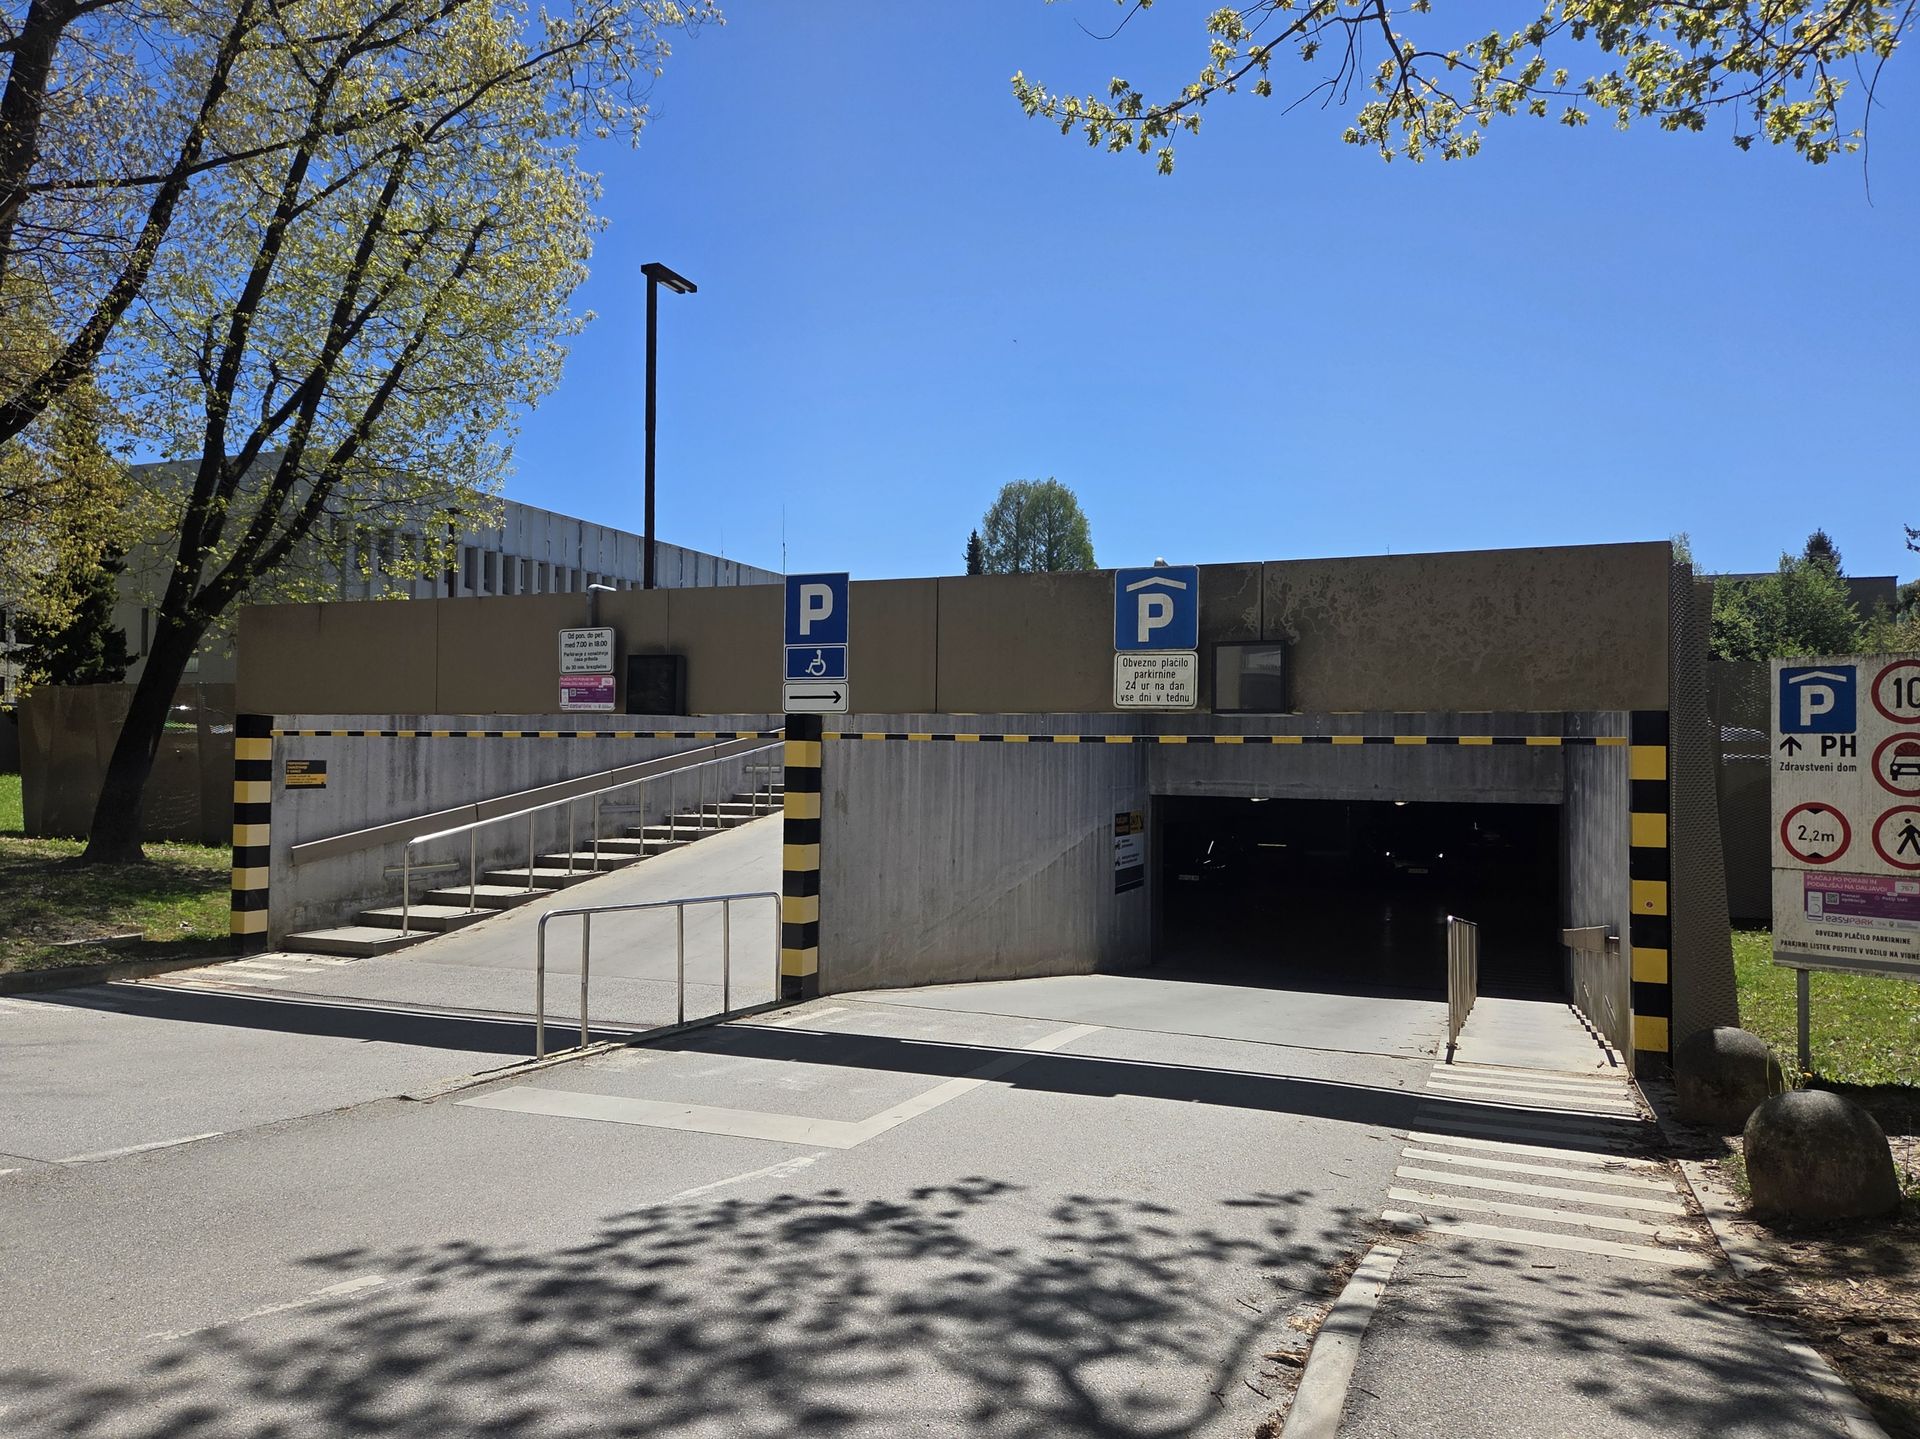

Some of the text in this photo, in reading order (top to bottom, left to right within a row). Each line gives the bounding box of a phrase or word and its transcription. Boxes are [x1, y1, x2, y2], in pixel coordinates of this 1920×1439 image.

[800, 583, 833, 635] P
[1138, 593, 1174, 642] P
[1122, 657, 1188, 669] Obvezno plačilo
[1134, 669, 1176, 680] parkirnine
[1125, 681, 1184, 690] 24 ur na dan
[1893, 676, 1920, 709] 10
[1120, 694, 1134, 702] vse
[1139, 693, 1151, 702] dni
[1166, 693, 1190, 702] tednu
[1800, 684, 1835, 726] P
[1821, 735, 1856, 757] PH
[1779, 762, 1857, 772] Zdravstveni dom
[1815, 929, 1911, 945] OBVEZNO PLAČILO PARKIRNINE
[1780, 939, 1808, 949] PARKIRNI
[1810, 942, 1831, 951] LISTEK
[1832, 945, 1857, 954] PUSTITE
[1865, 948, 1887, 957] VOZILU
[1889, 951, 1899, 959] NA
